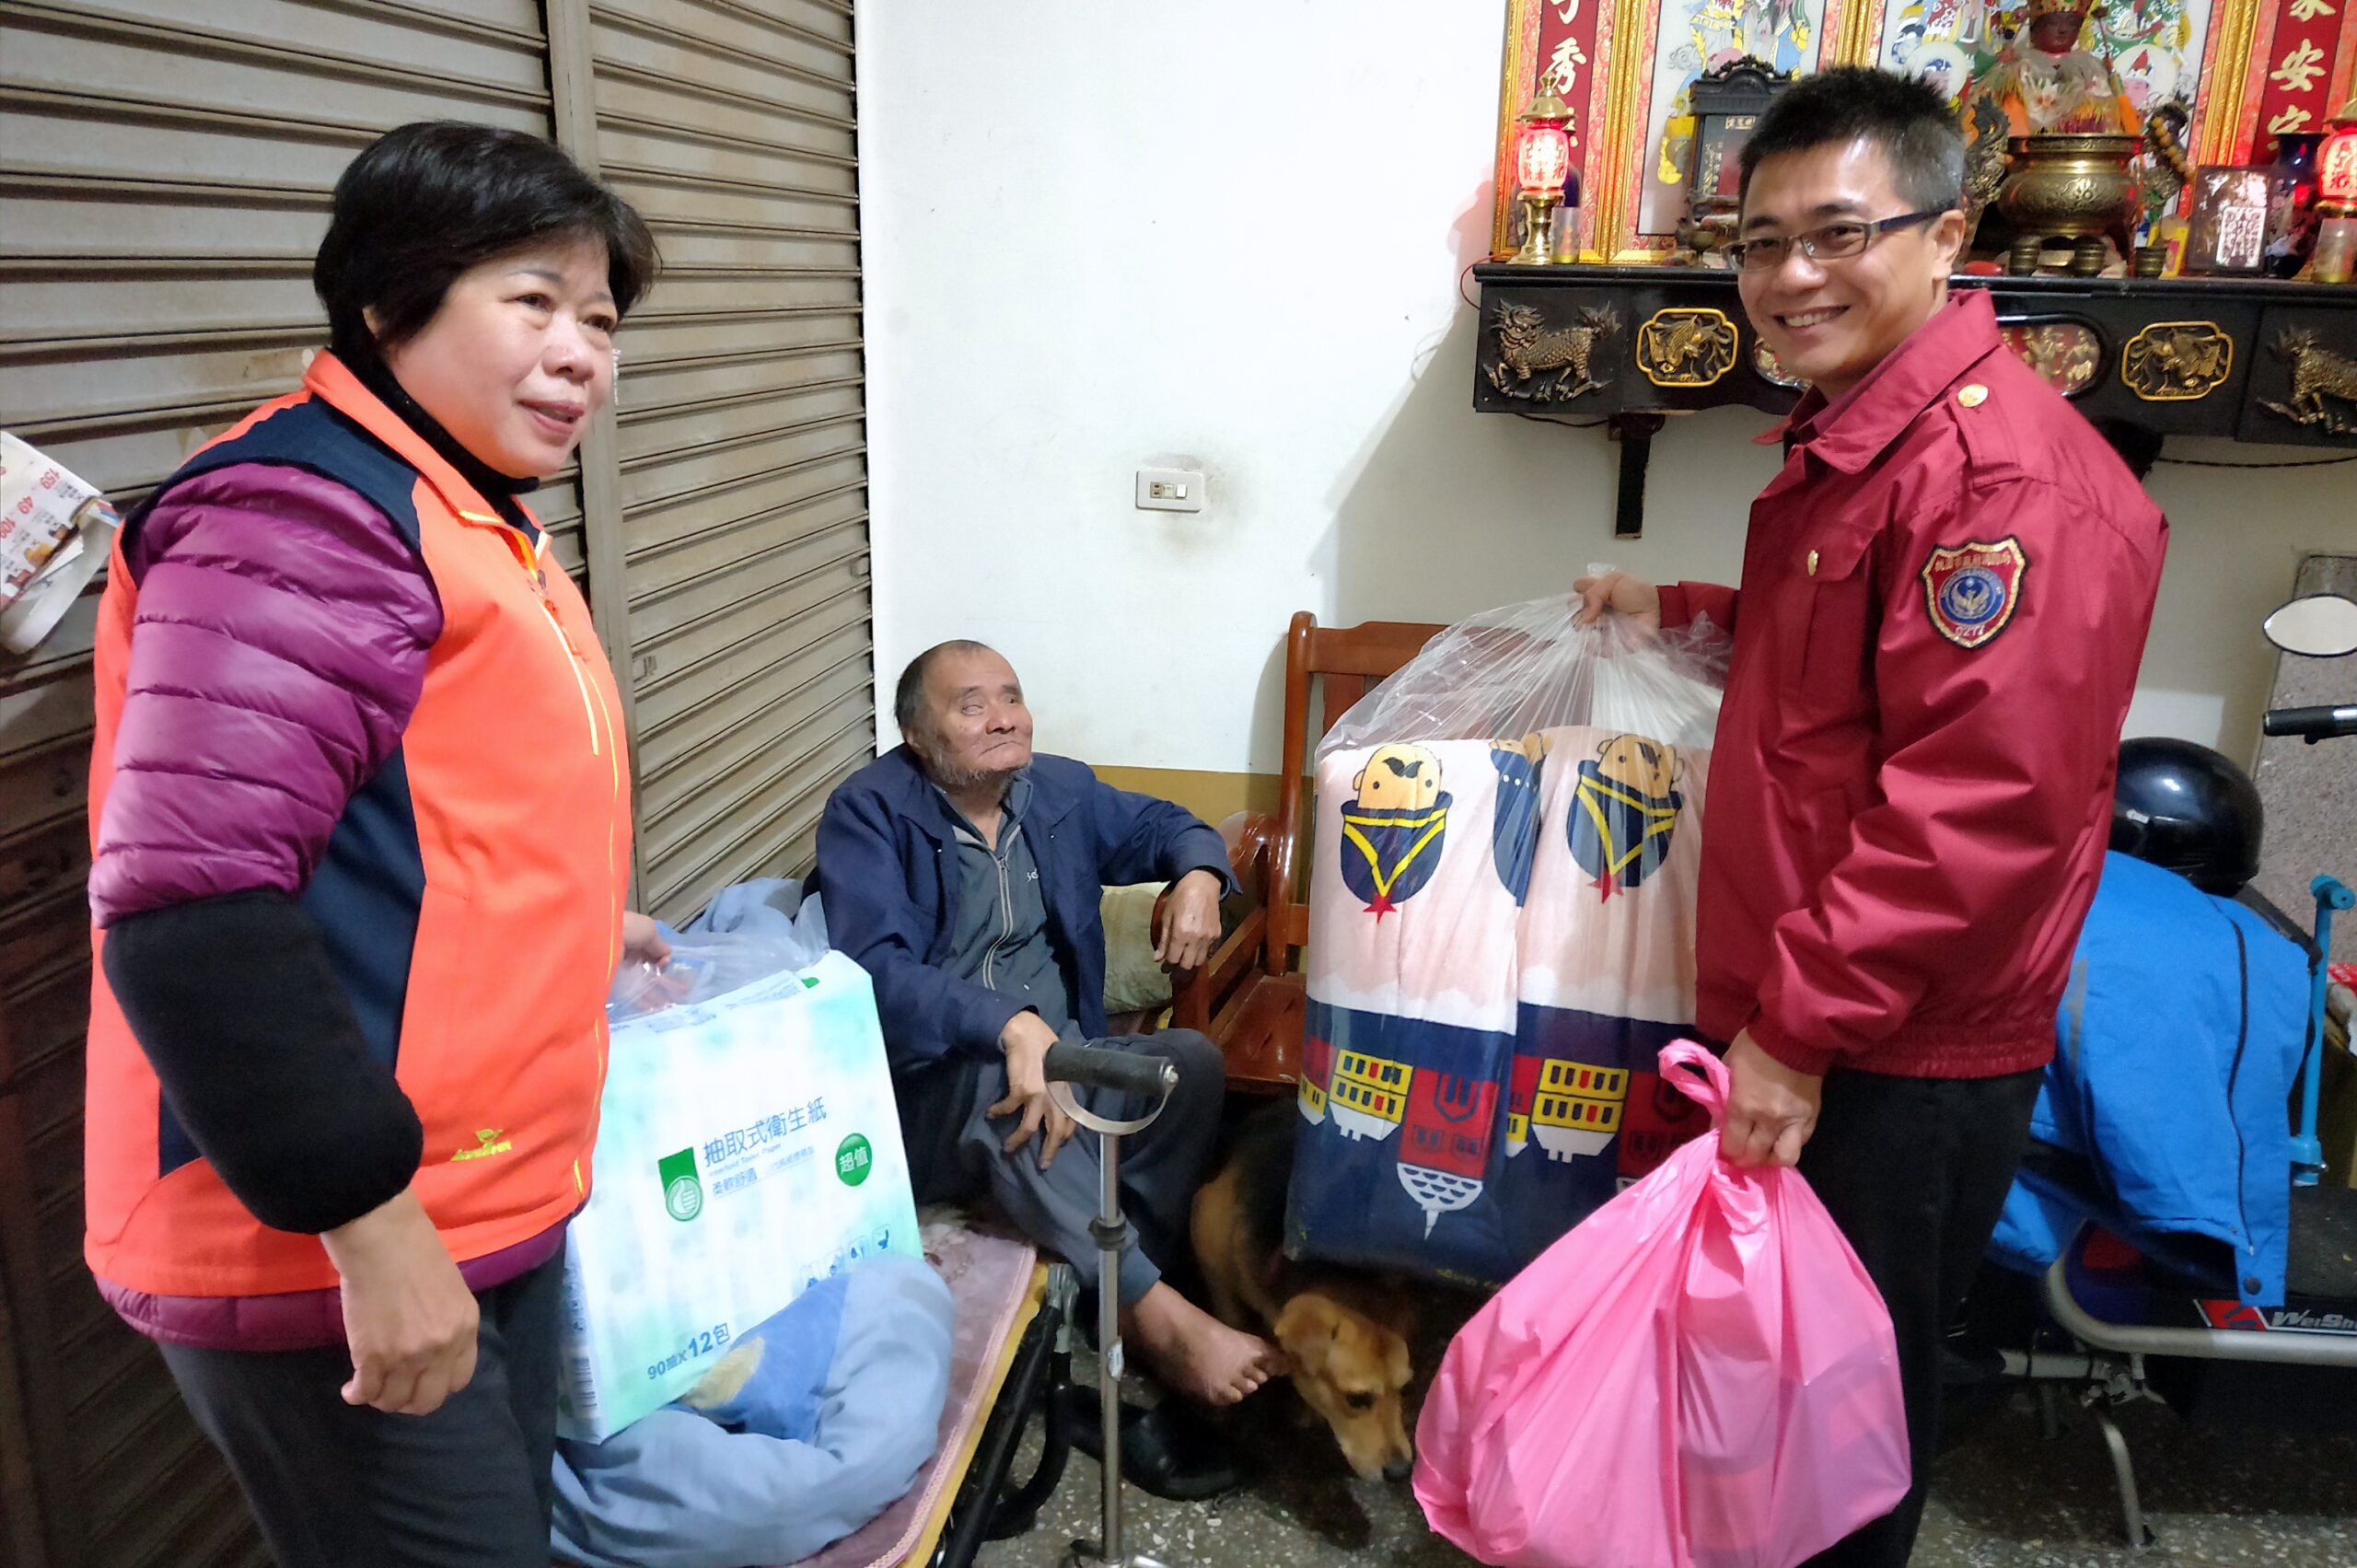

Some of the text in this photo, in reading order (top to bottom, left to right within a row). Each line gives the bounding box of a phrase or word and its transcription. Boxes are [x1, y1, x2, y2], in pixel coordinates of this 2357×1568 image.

[702, 1096, 827, 1167] 抽取式衛生紙
[839, 1146, 869, 1175] 超值
